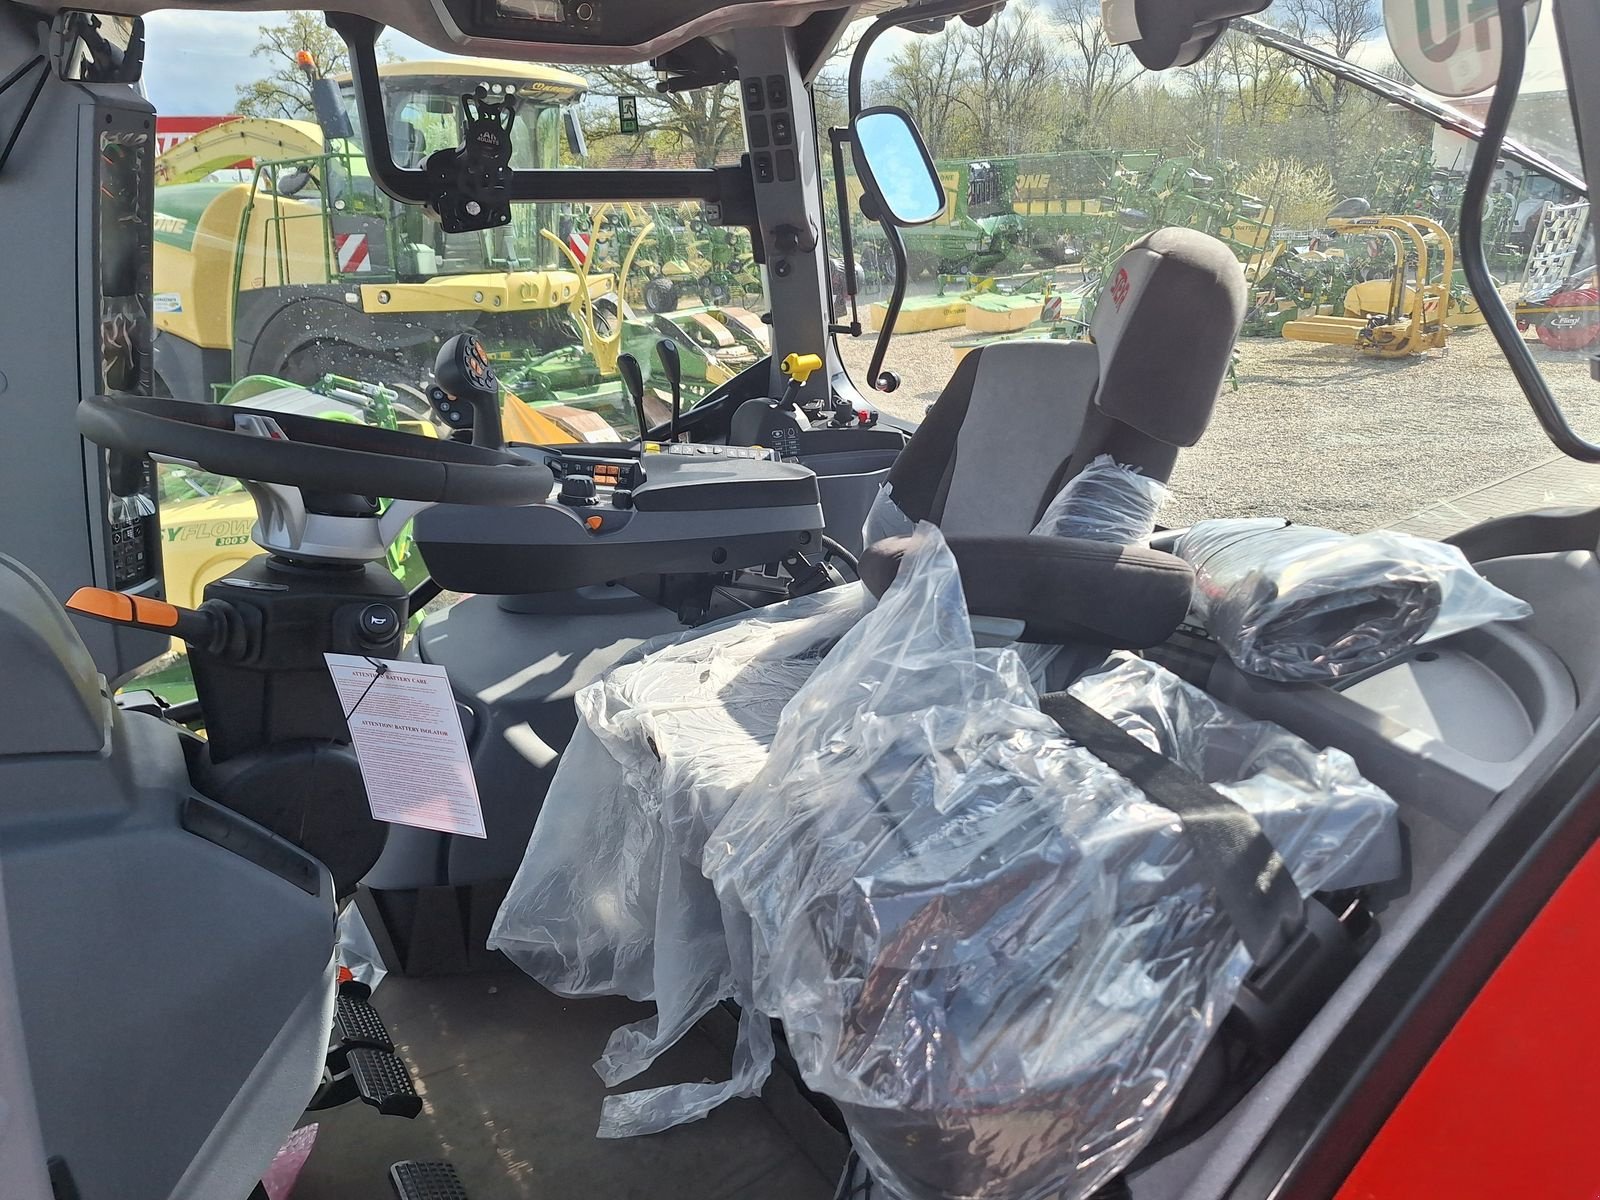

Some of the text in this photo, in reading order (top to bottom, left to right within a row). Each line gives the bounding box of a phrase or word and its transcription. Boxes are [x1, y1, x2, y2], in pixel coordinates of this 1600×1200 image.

[386, 674, 411, 683] BATTERY
[411, 677, 427, 685] CARE
[361, 720, 449, 737] ATTENTION! BATTERY ISOLATOR
